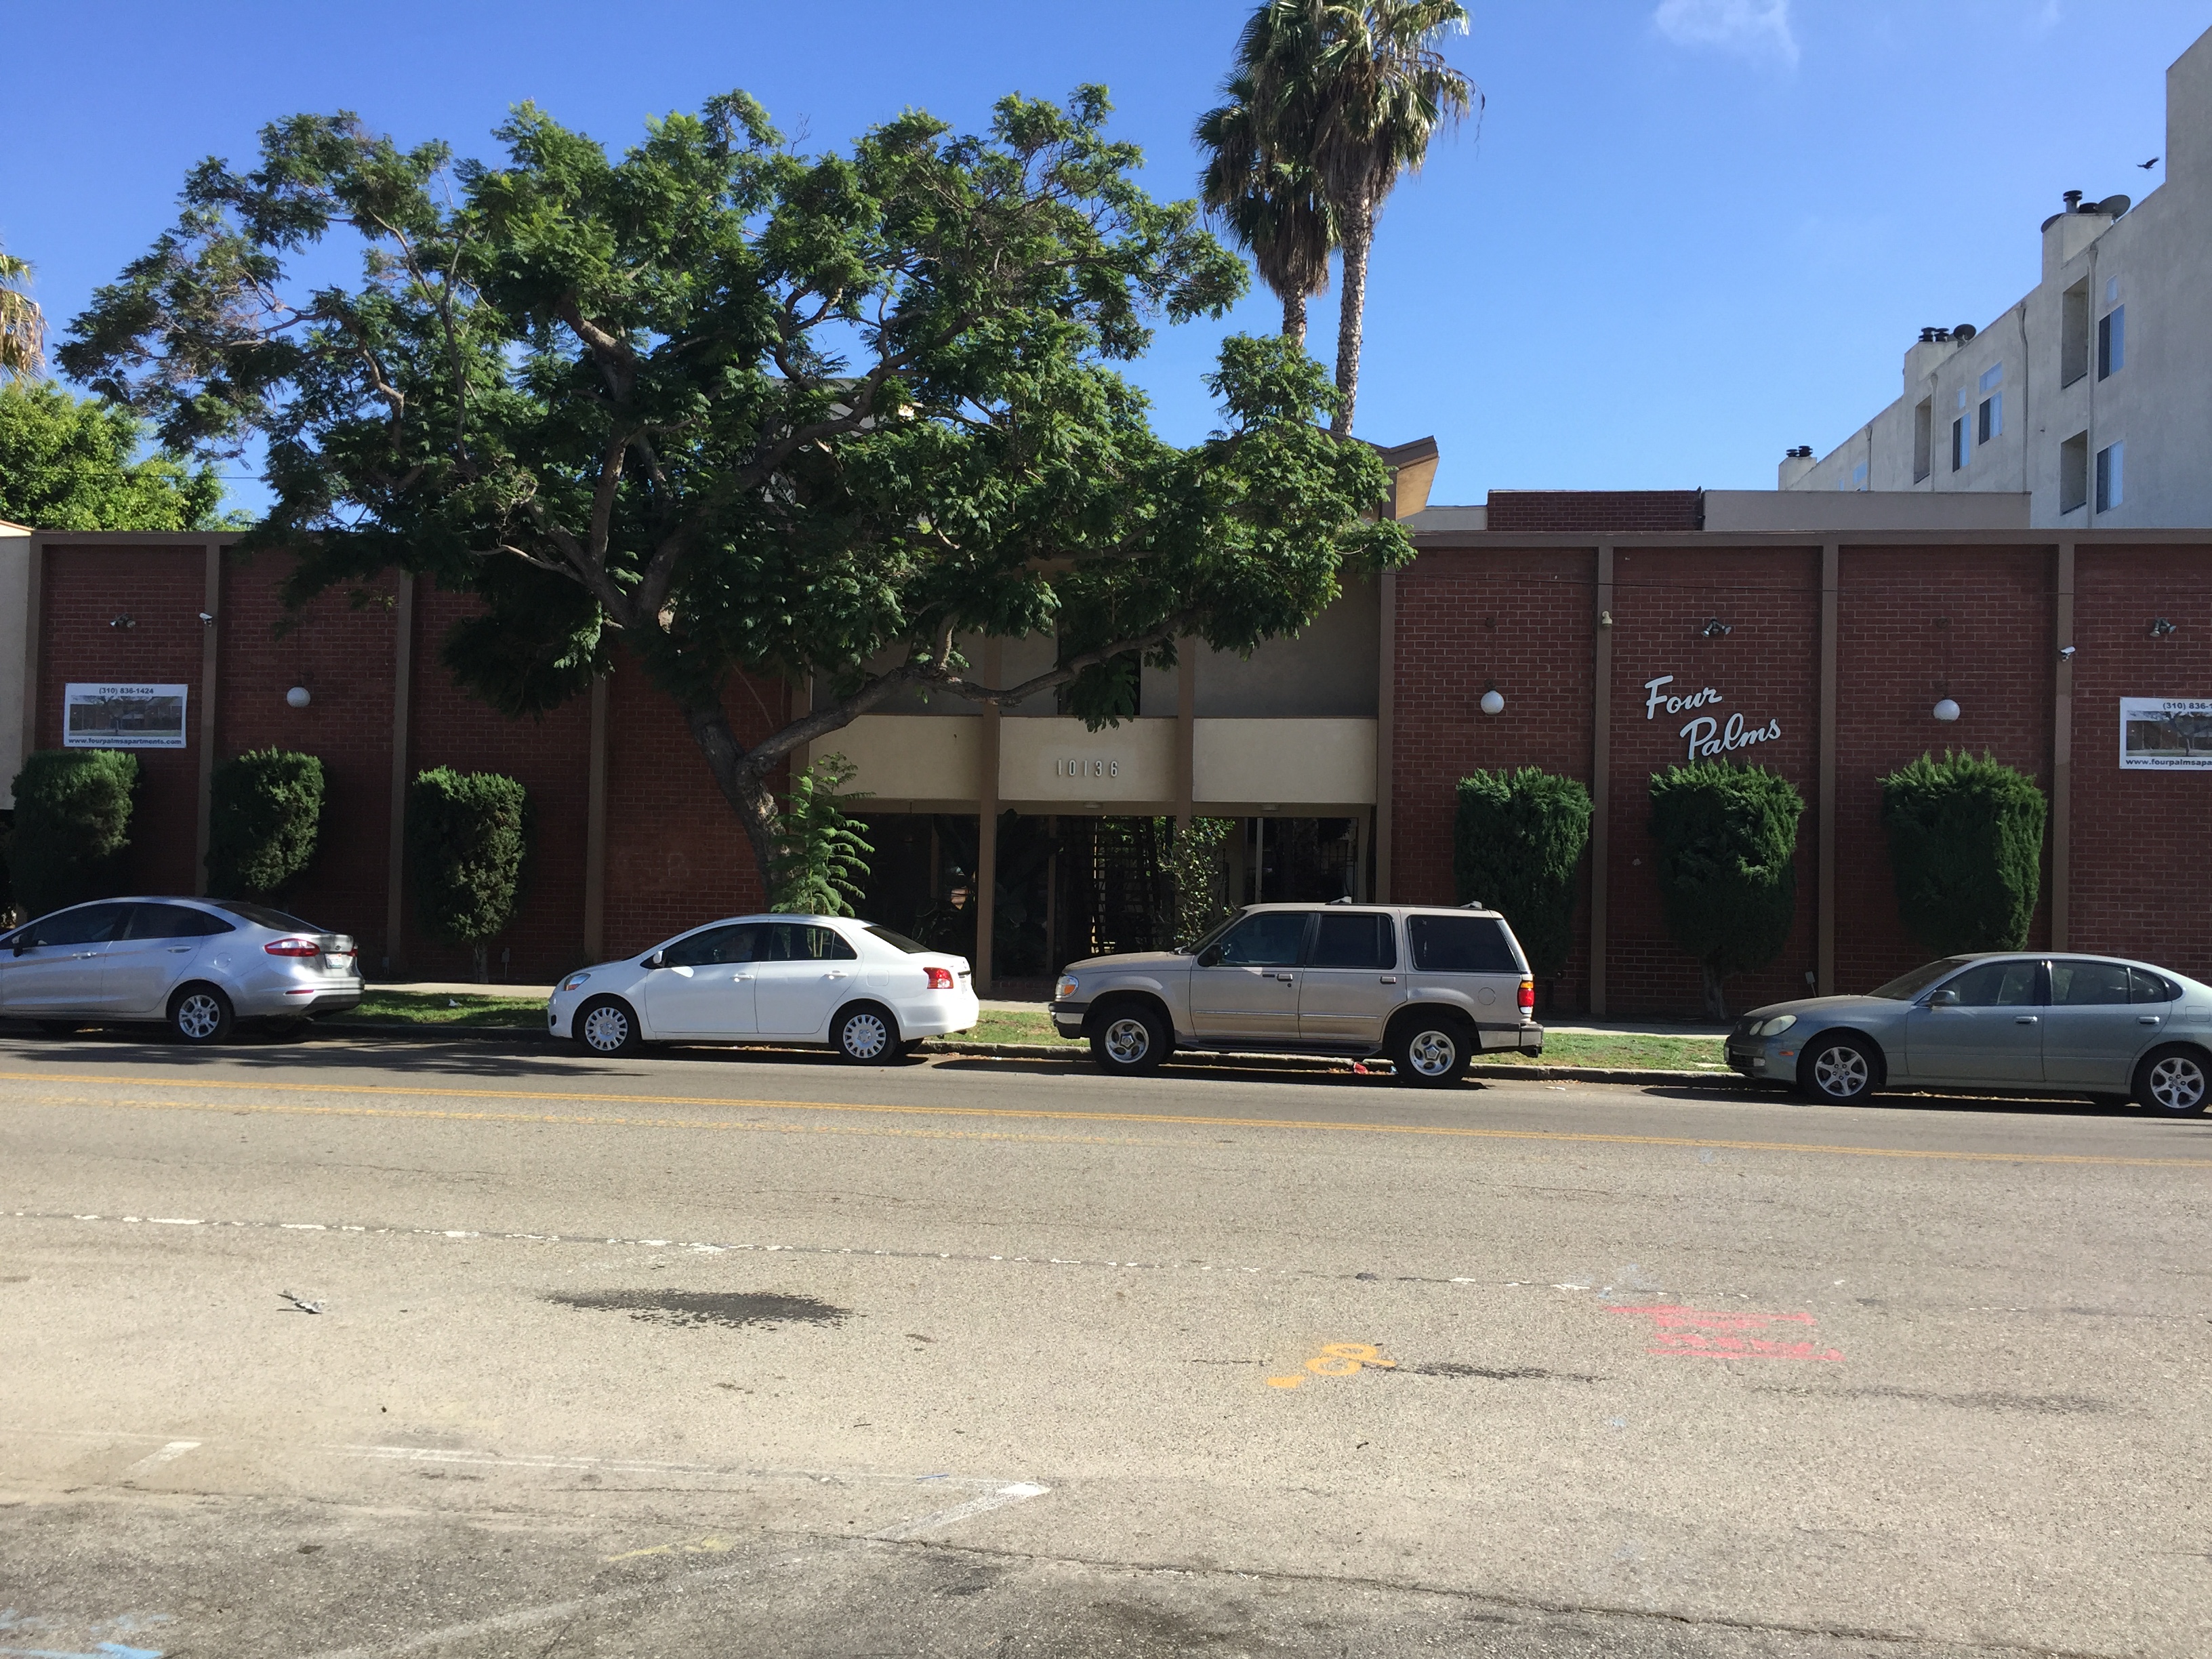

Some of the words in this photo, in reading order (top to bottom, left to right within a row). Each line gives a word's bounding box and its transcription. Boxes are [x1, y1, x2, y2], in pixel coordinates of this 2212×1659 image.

[1645, 675, 1722, 720] Four
[2163, 702, 2186, 710] (310)
[1680, 713, 1781, 760] Palms
[1058, 759, 1118, 777] 10136
